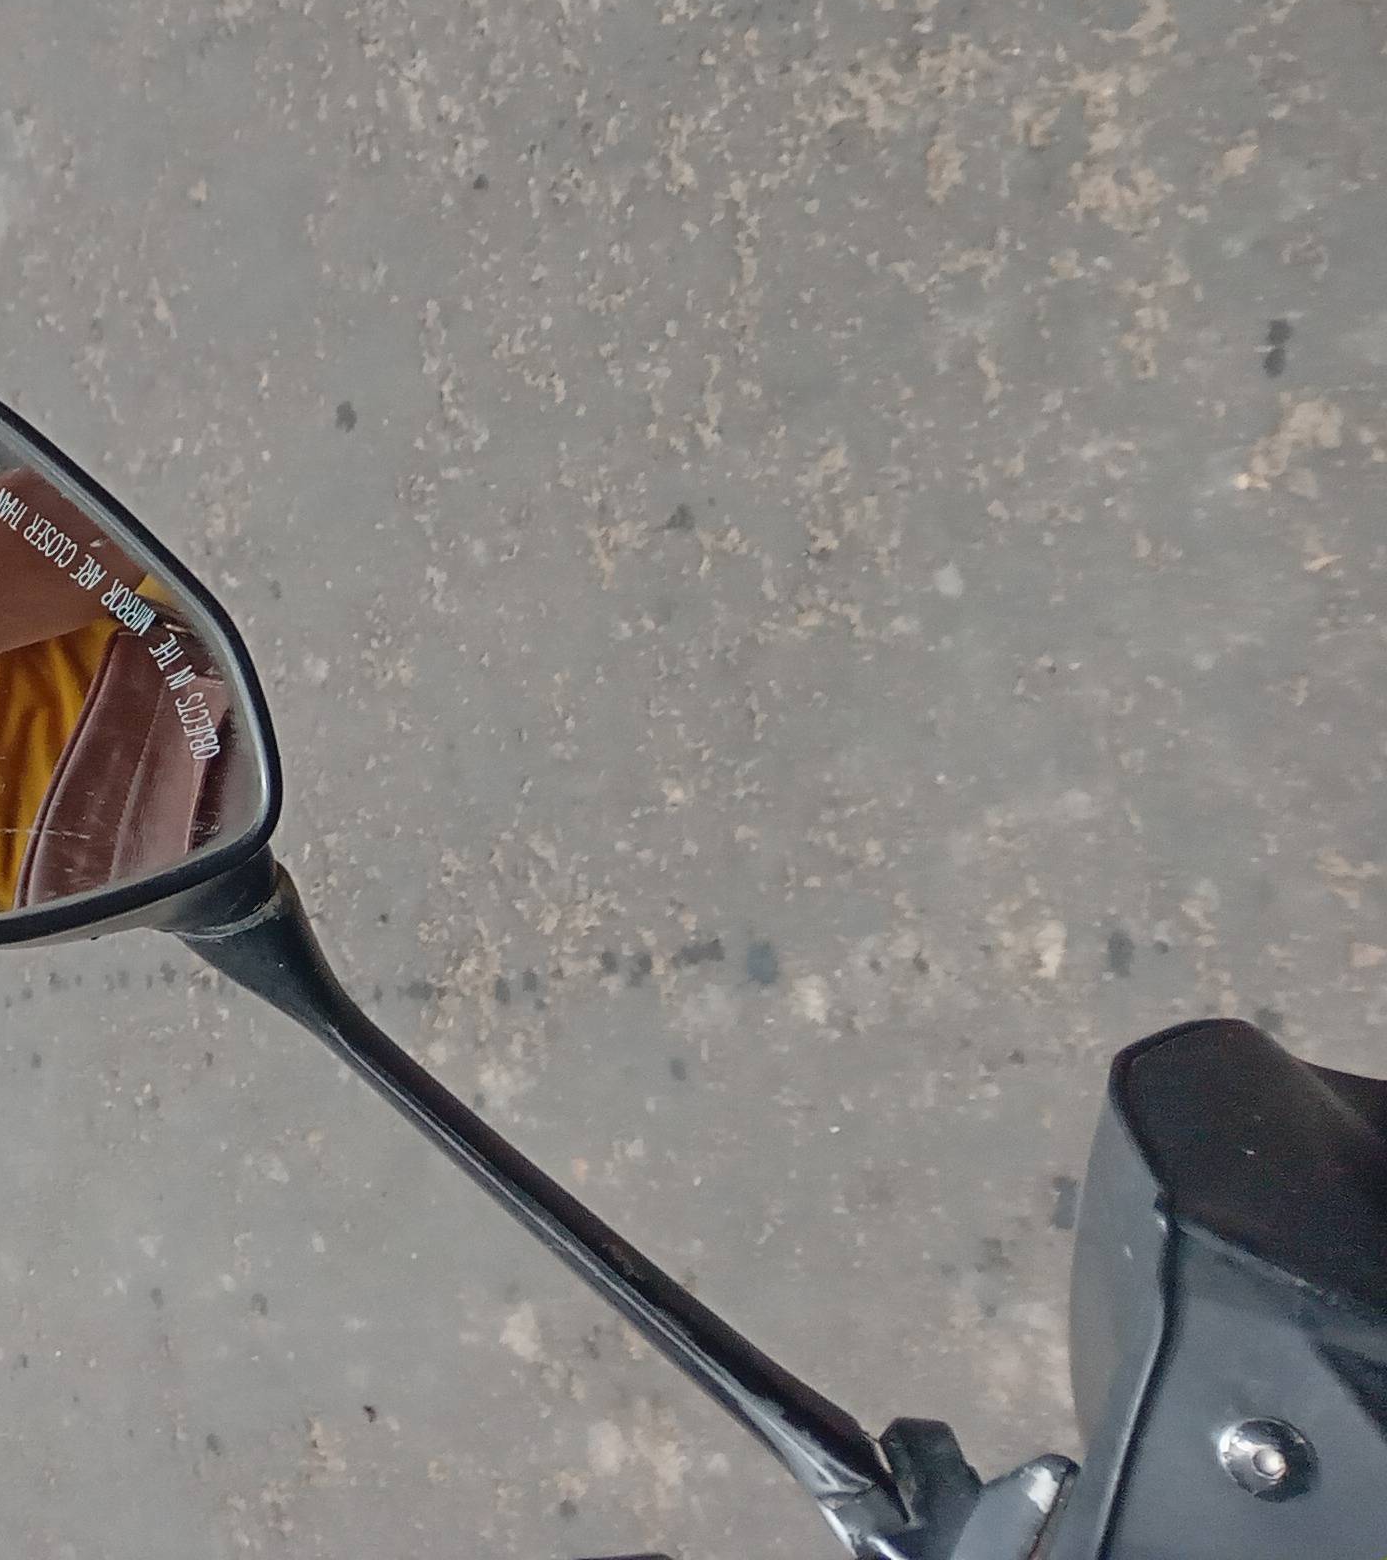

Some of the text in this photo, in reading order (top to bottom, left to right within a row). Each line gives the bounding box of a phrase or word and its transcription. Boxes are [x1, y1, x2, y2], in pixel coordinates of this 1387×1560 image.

[23, 512, 78, 568] CLOSER
[69, 553, 108, 591] ARE
[100, 578, 157, 637] MIRROR
[148, 632, 185, 671] THE
[165, 664, 197, 691] IN
[175, 692, 221, 760] OBJECTS
